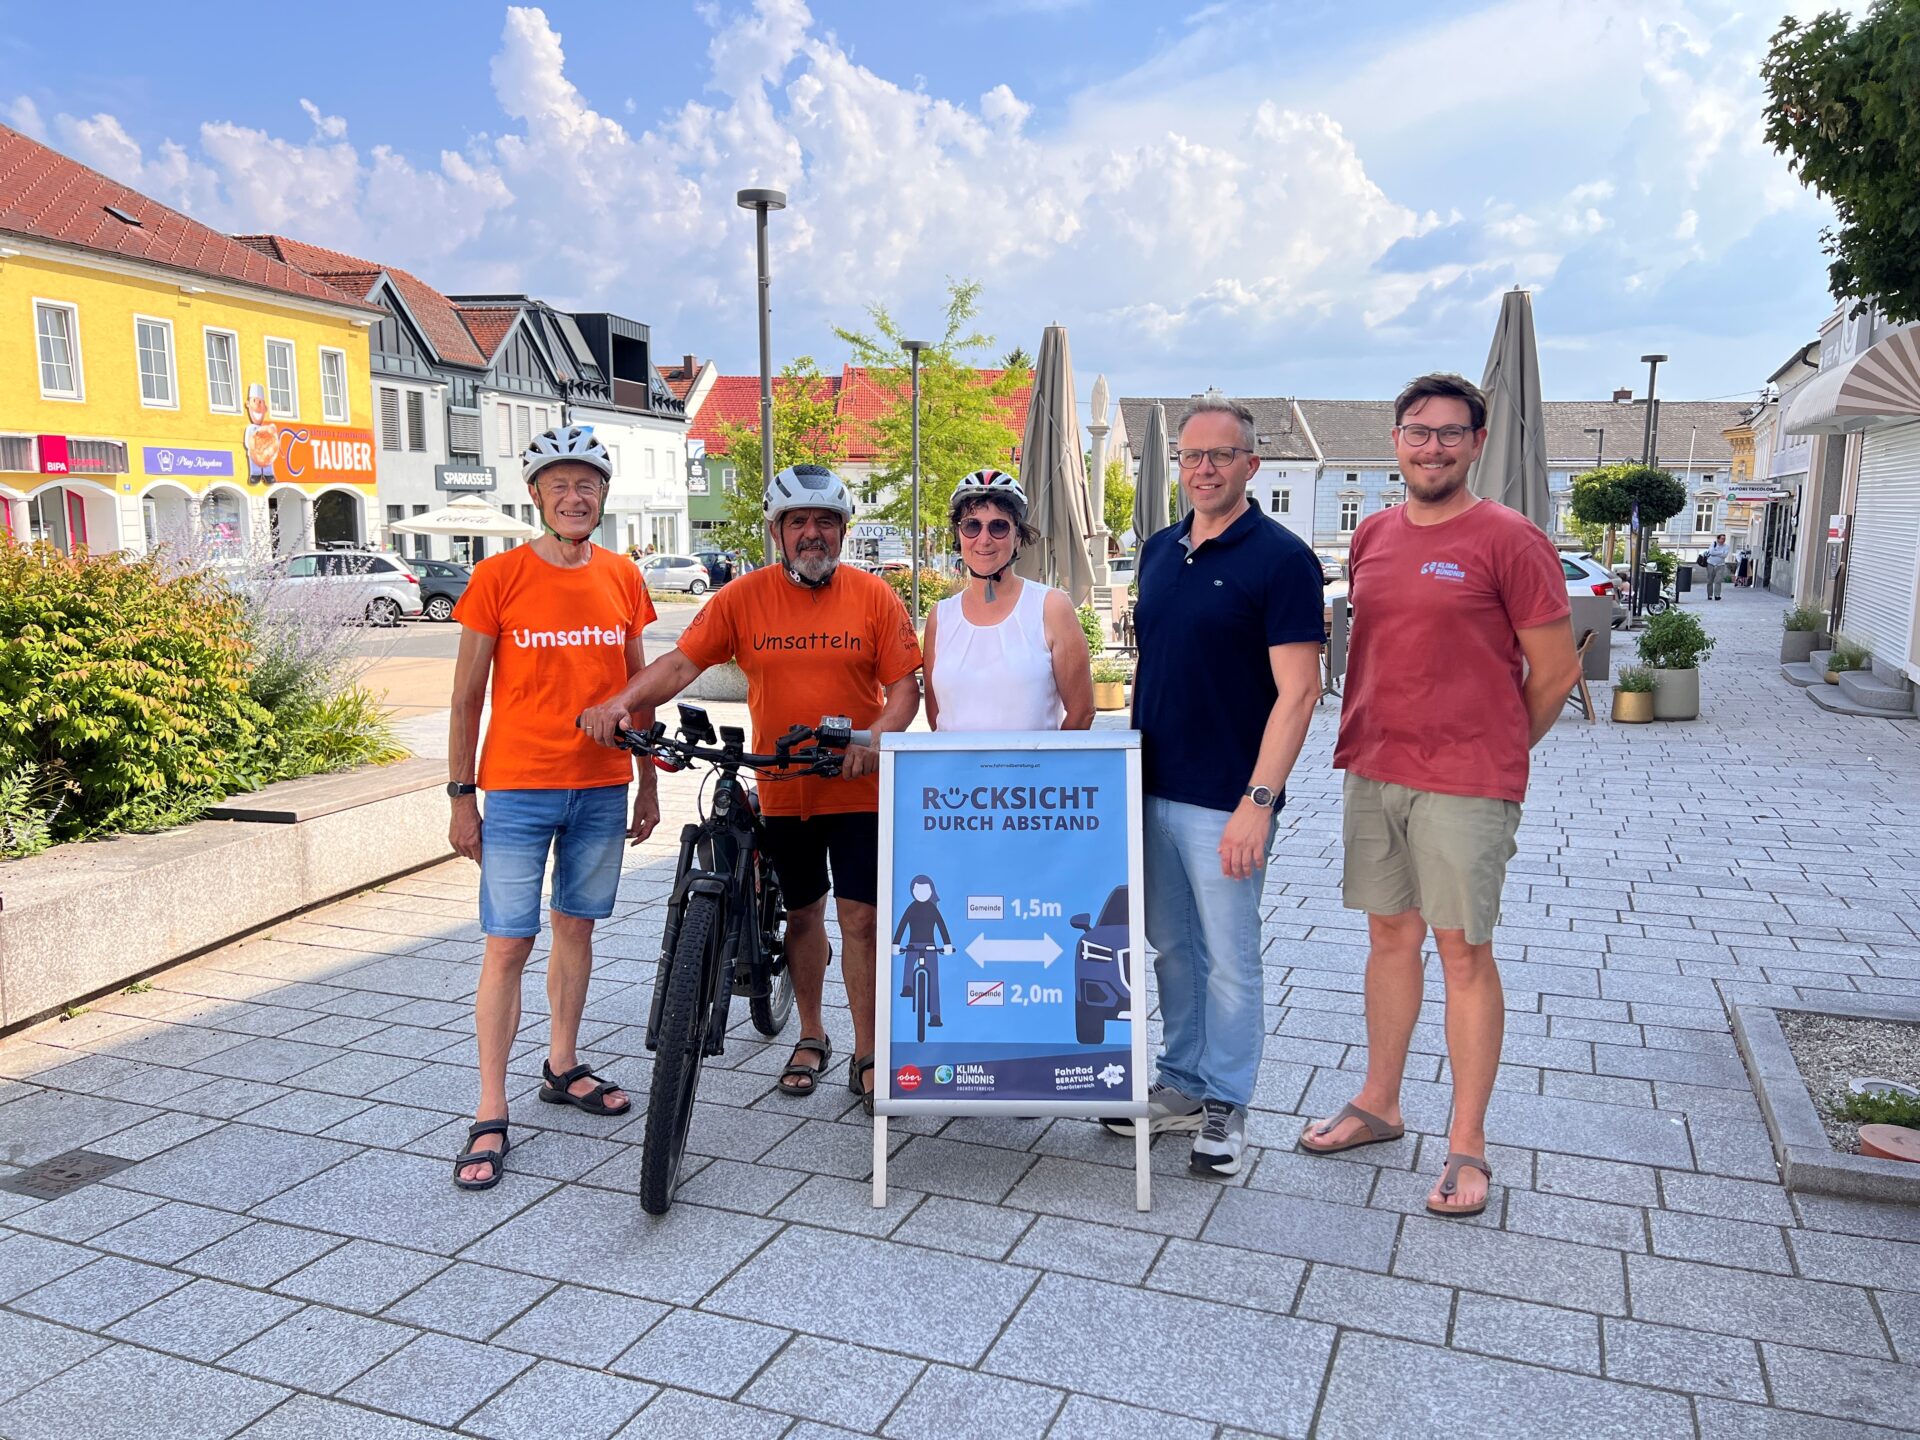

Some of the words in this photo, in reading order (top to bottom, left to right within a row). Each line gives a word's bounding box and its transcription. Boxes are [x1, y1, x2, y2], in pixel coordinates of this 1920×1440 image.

[310, 439, 372, 471] TAUBER
[47, 461, 67, 472] BIPA
[443, 471, 484, 485] SPARKASSE
[1437, 562, 1458, 570] KLIMA
[753, 631, 861, 651] Umsatteln
[922, 786, 1099, 809] RÜCKSICHT
[923, 815, 993, 831] DURCH
[1001, 815, 1100, 831] ABSTAND
[969, 904, 1002, 912] Gemeinde
[1010, 898, 1062, 920] 1,5m
[1010, 984, 1063, 1007] 2,0m
[956, 1064, 985, 1074] KLIMA
[1054, 1065, 1094, 1077] FahrRad
[956, 1073, 995, 1084] BÜNDNIS
[1055, 1075, 1095, 1084] BERATUNG
